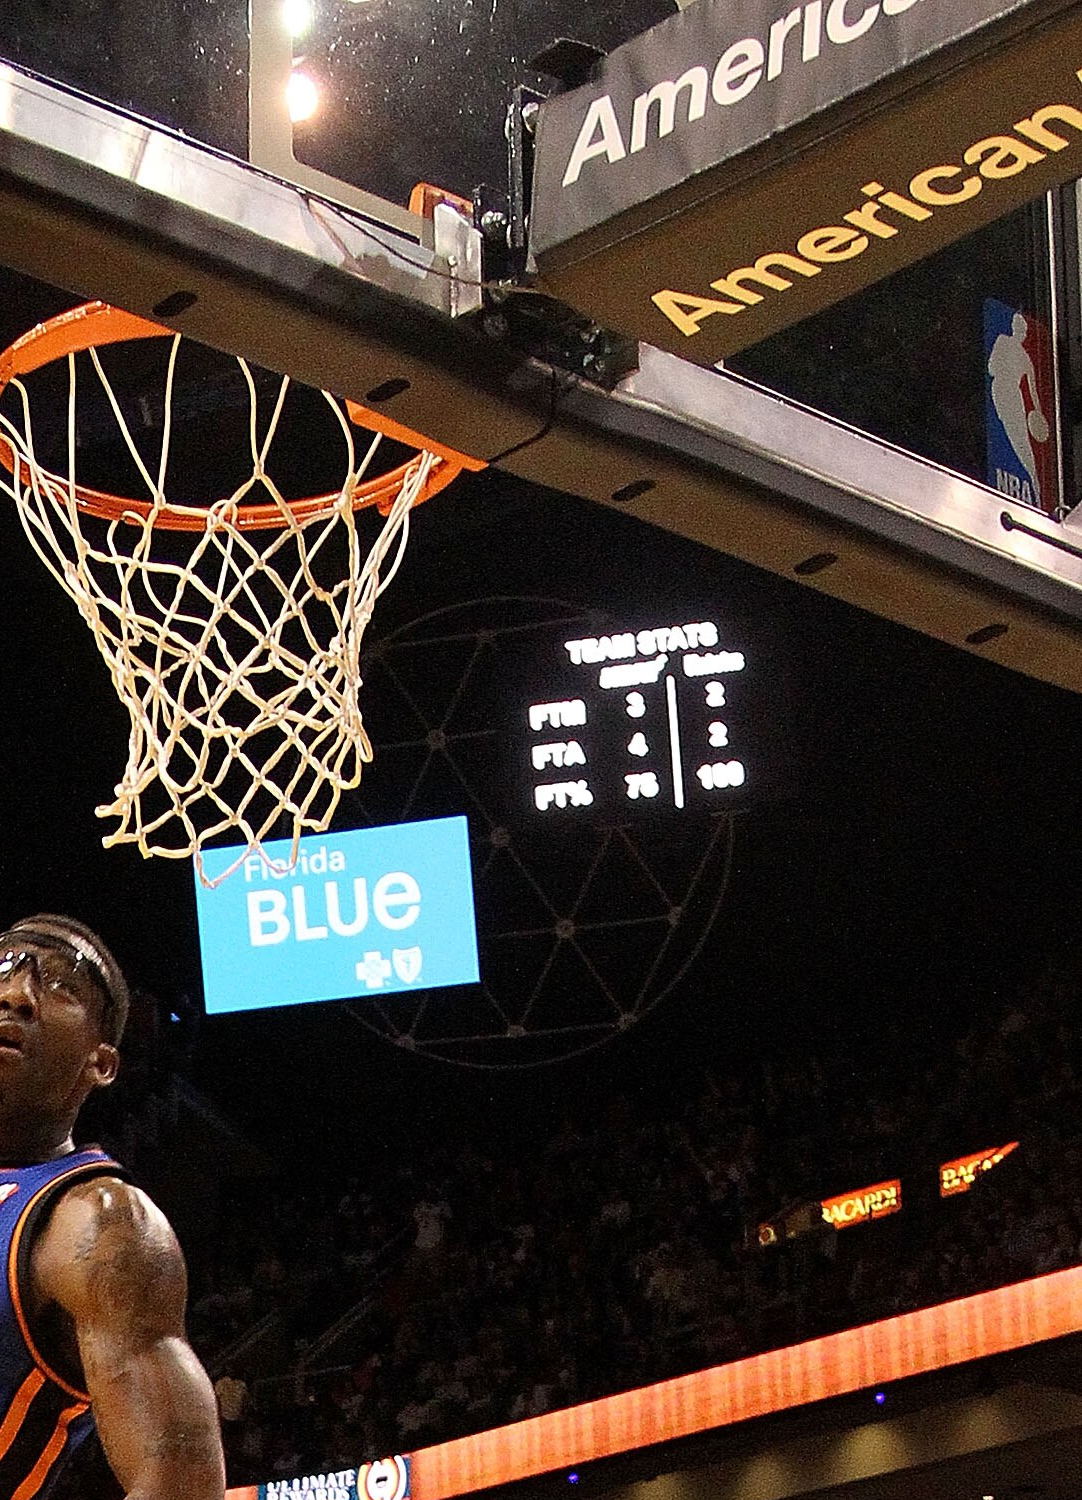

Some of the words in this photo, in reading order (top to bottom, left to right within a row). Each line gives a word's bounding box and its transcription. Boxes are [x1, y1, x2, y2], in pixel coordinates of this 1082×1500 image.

[562, 0, 921, 187] Americ
[651, 104, 1082, 336] American
[636, 621, 718, 656] STATS
[531, 739, 587, 771] FTA
[627, 731, 650, 758] 4
[243, 846, 346, 882] Florida
